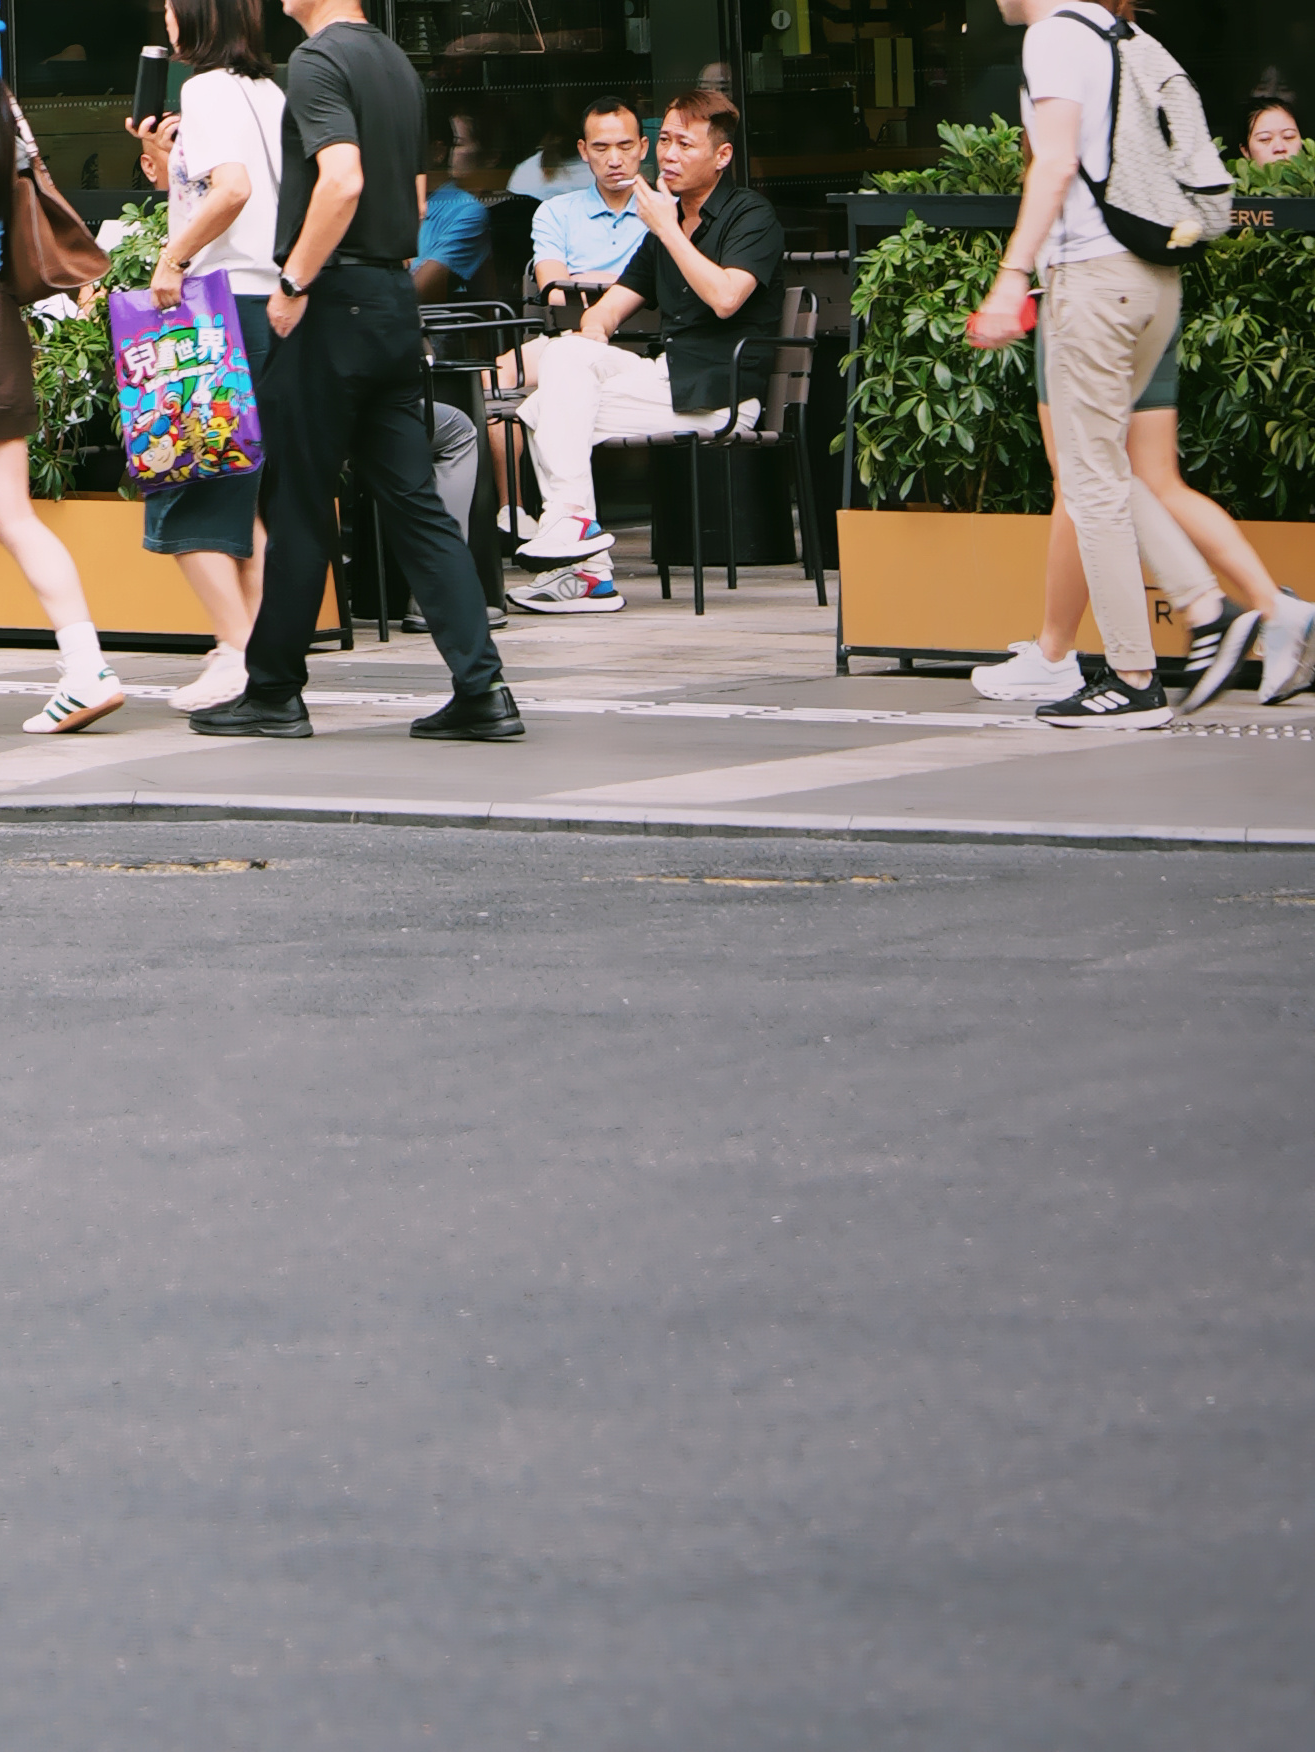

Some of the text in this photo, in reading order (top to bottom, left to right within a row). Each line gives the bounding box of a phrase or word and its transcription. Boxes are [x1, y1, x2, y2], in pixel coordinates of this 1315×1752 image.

[1229, 210, 1275, 227] ERVE
[123, 326, 228, 385] 兒童世界
